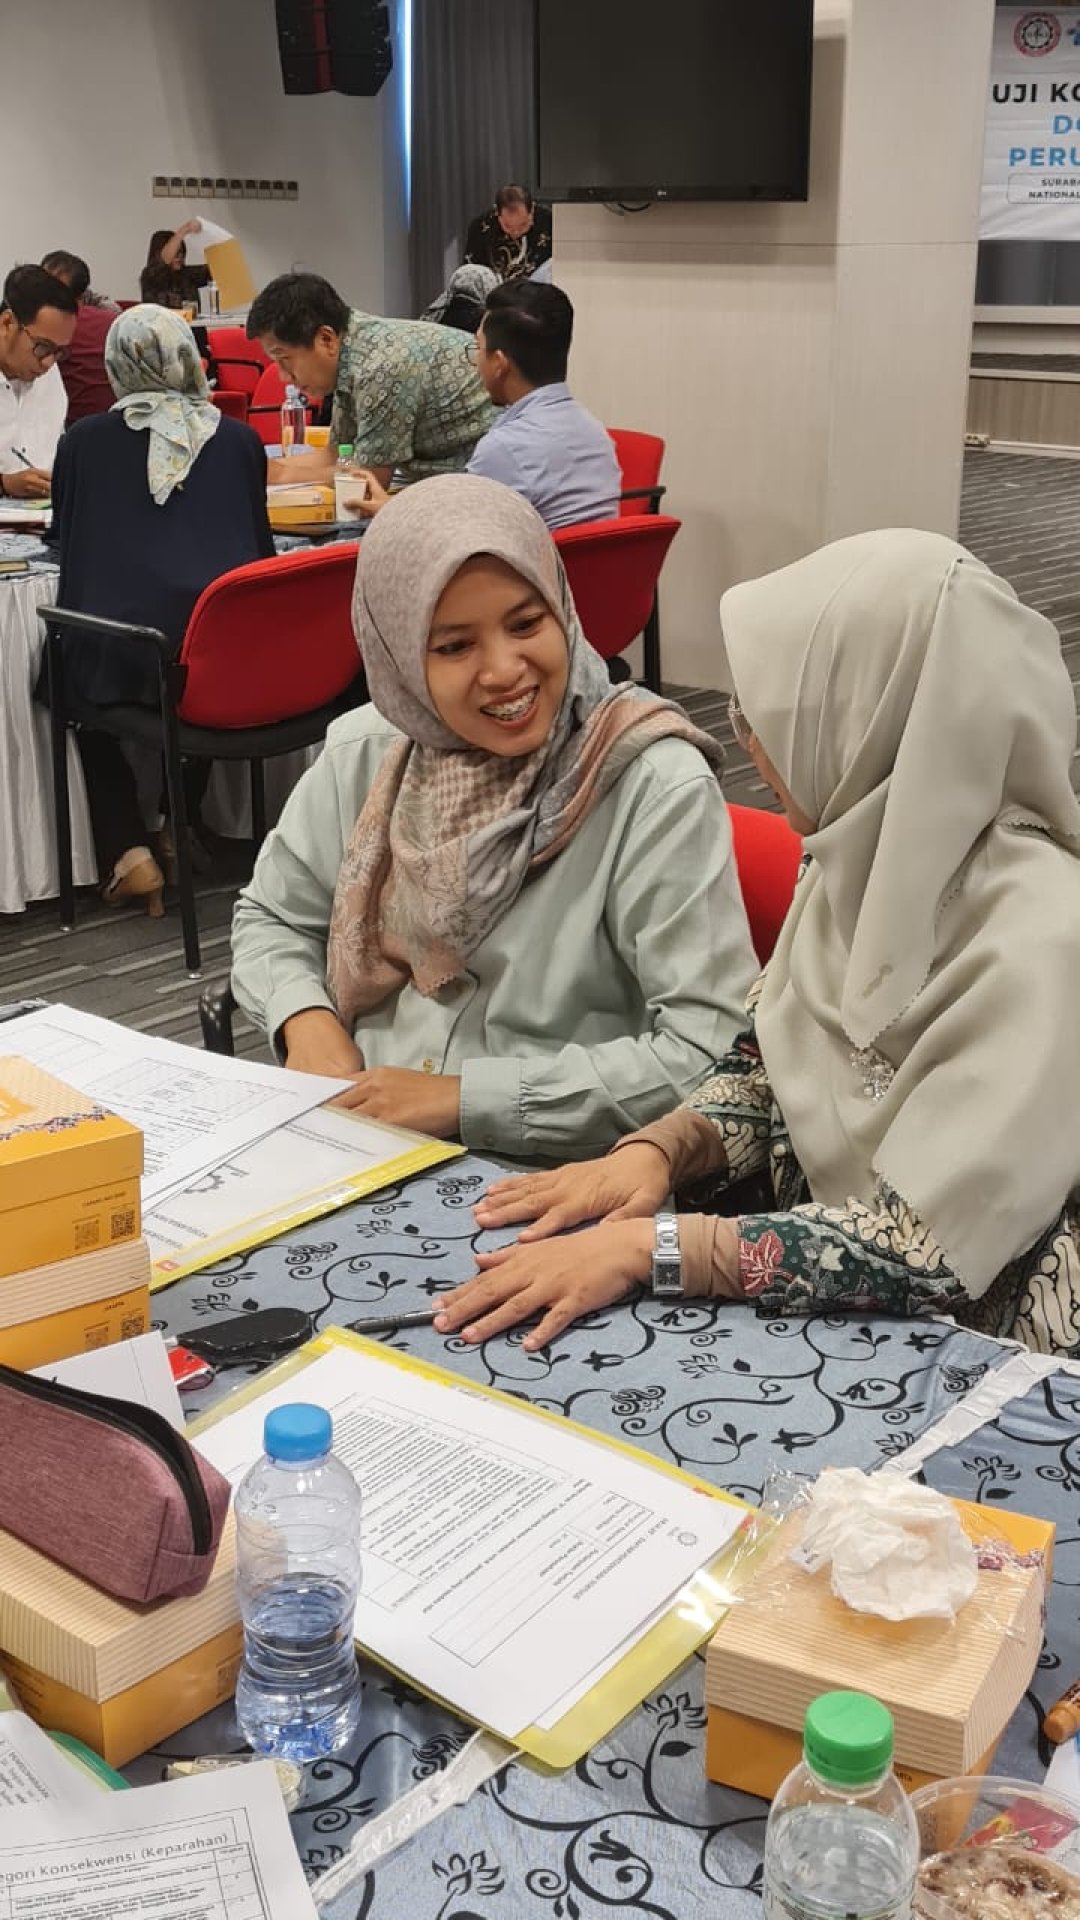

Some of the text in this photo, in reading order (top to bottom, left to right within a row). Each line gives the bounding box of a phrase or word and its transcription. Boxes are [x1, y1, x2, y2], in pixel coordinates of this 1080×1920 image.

[992, 83, 1037, 103] UJI
[1053, 115, 1080, 135] D
[1028, 191, 1080, 199] NATIONAL
[40, 1852, 136, 1875] Konsekwensi
[141, 1834, 228, 1859] (Keparahan)
